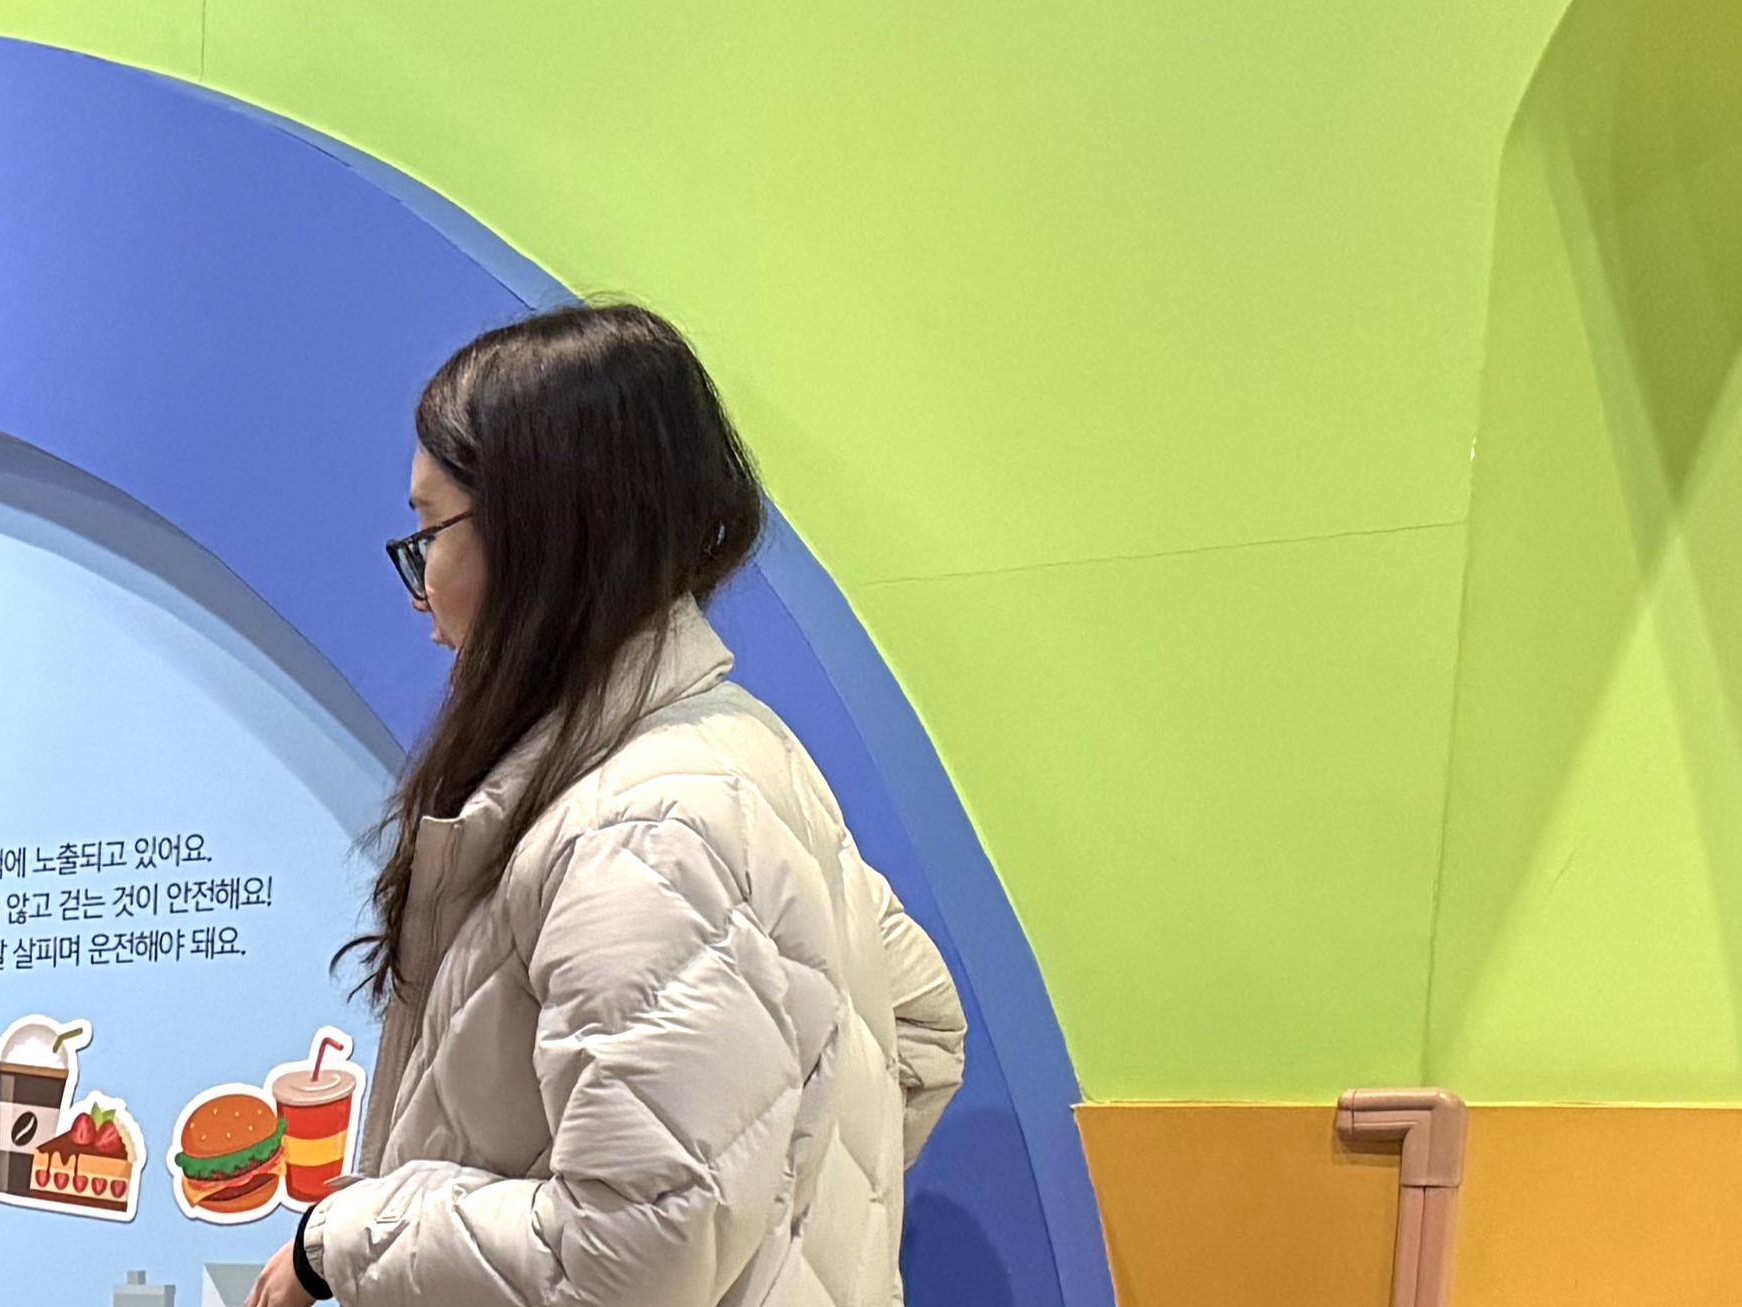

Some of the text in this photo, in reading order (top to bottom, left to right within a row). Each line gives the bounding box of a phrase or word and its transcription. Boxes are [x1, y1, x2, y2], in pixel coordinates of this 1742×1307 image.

[32, 840, 127, 875] 노출되고
[135, 833, 212, 870] 있어요.
[7, 892, 52, 925] 않고
[60, 888, 105, 922] 걷는
[113, 883, 158, 919] 것이
[167, 875, 272, 915] 안전해요!
[14, 934, 81, 970] 살피며
[88, 928, 185, 966] 운전해야
[190, 925, 246, 961] 돼요.
